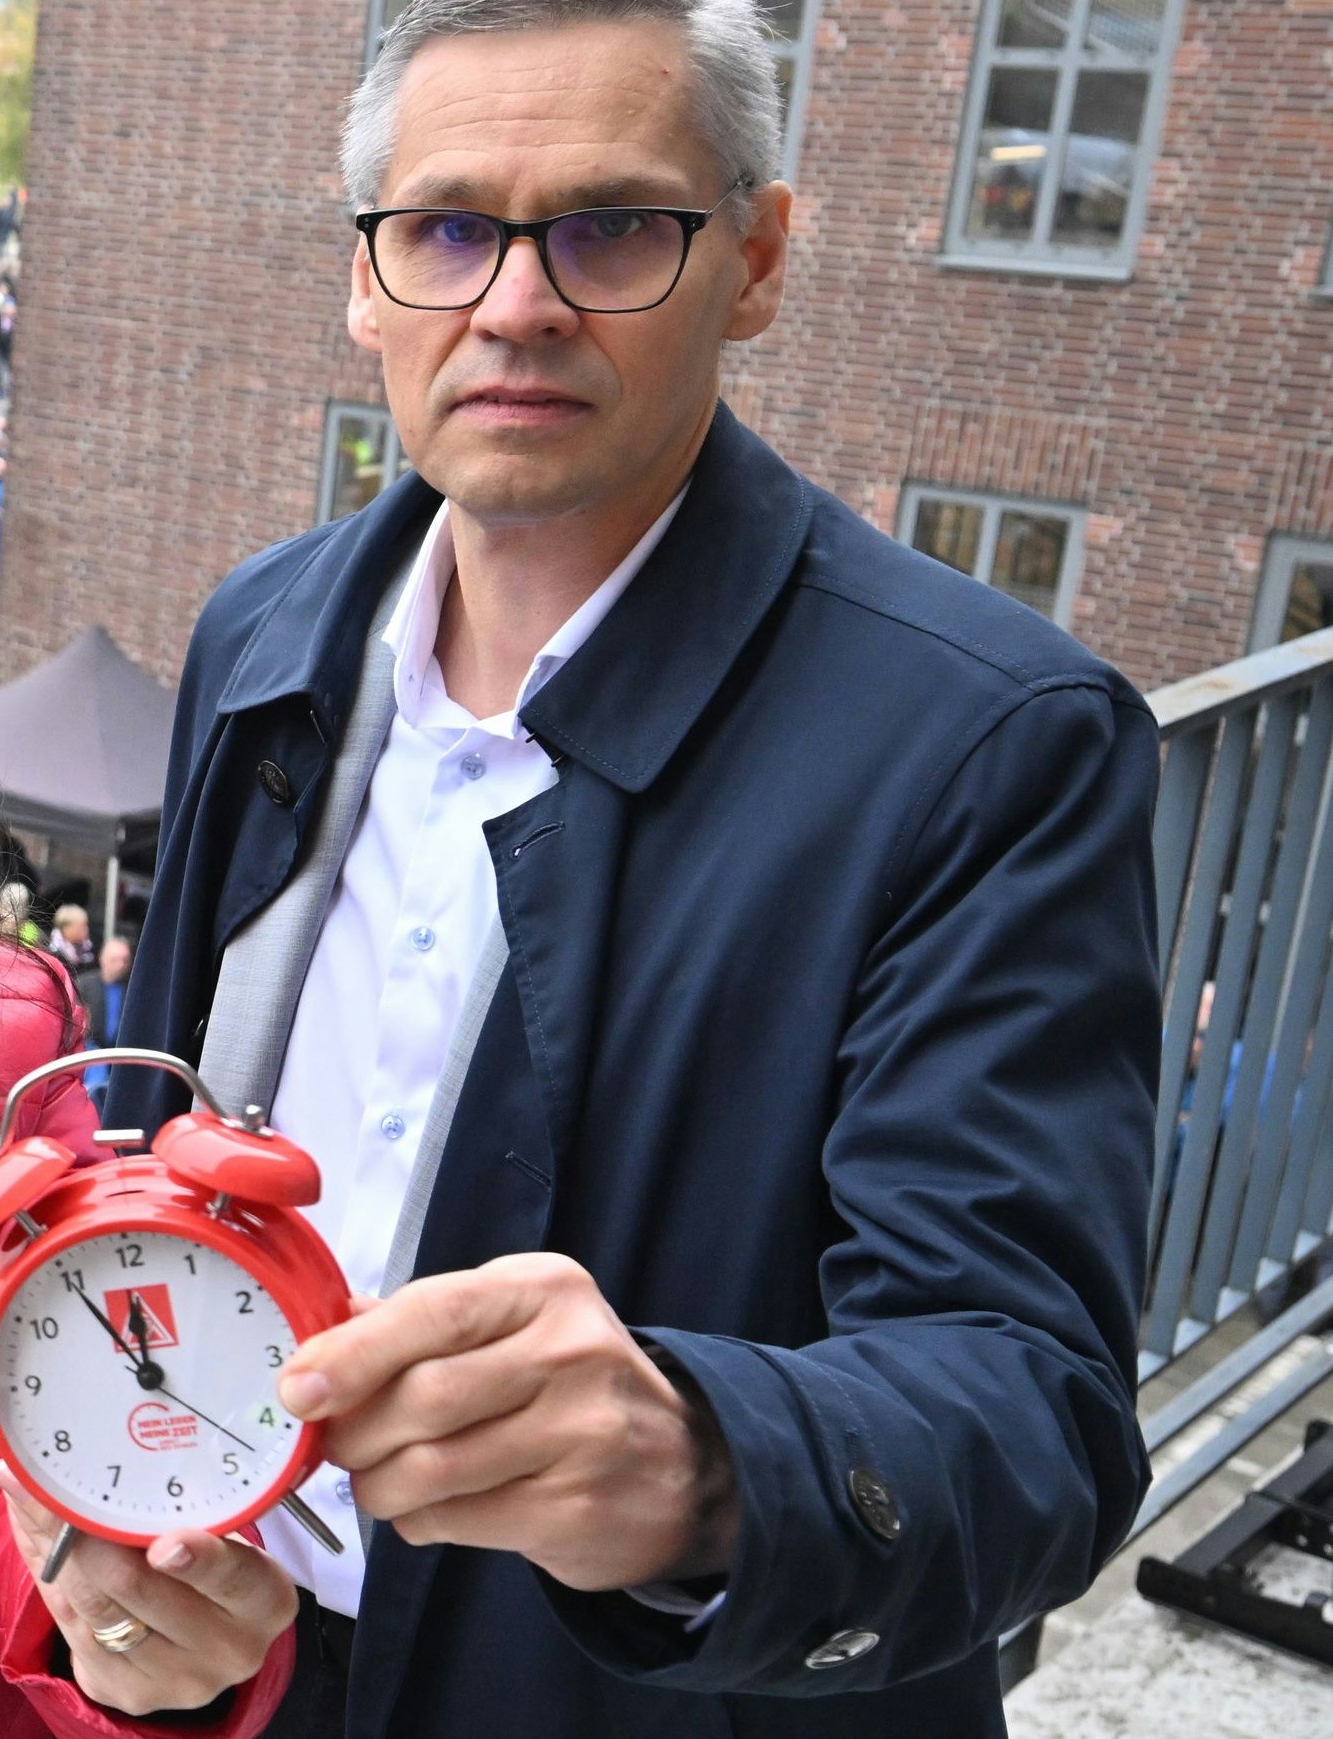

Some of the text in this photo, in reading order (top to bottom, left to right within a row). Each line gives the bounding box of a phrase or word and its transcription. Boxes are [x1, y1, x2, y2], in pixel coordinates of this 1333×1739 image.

[116, 1244, 145, 1268] 12
[185, 1254, 197, 1275] 1
[60, 1269, 86, 1292] 11
[236, 1291, 254, 1314] 2
[30, 1317, 59, 1340] 10
[266, 1346, 283, 1368] 3
[25, 1375, 41, 1396] 9
[259, 1407, 276, 1428] 4
[54, 1431, 71, 1452] 8
[223, 1453, 239, 1475] 5
[107, 1466, 122, 1488] 7
[167, 1476, 183, 1497] 6
